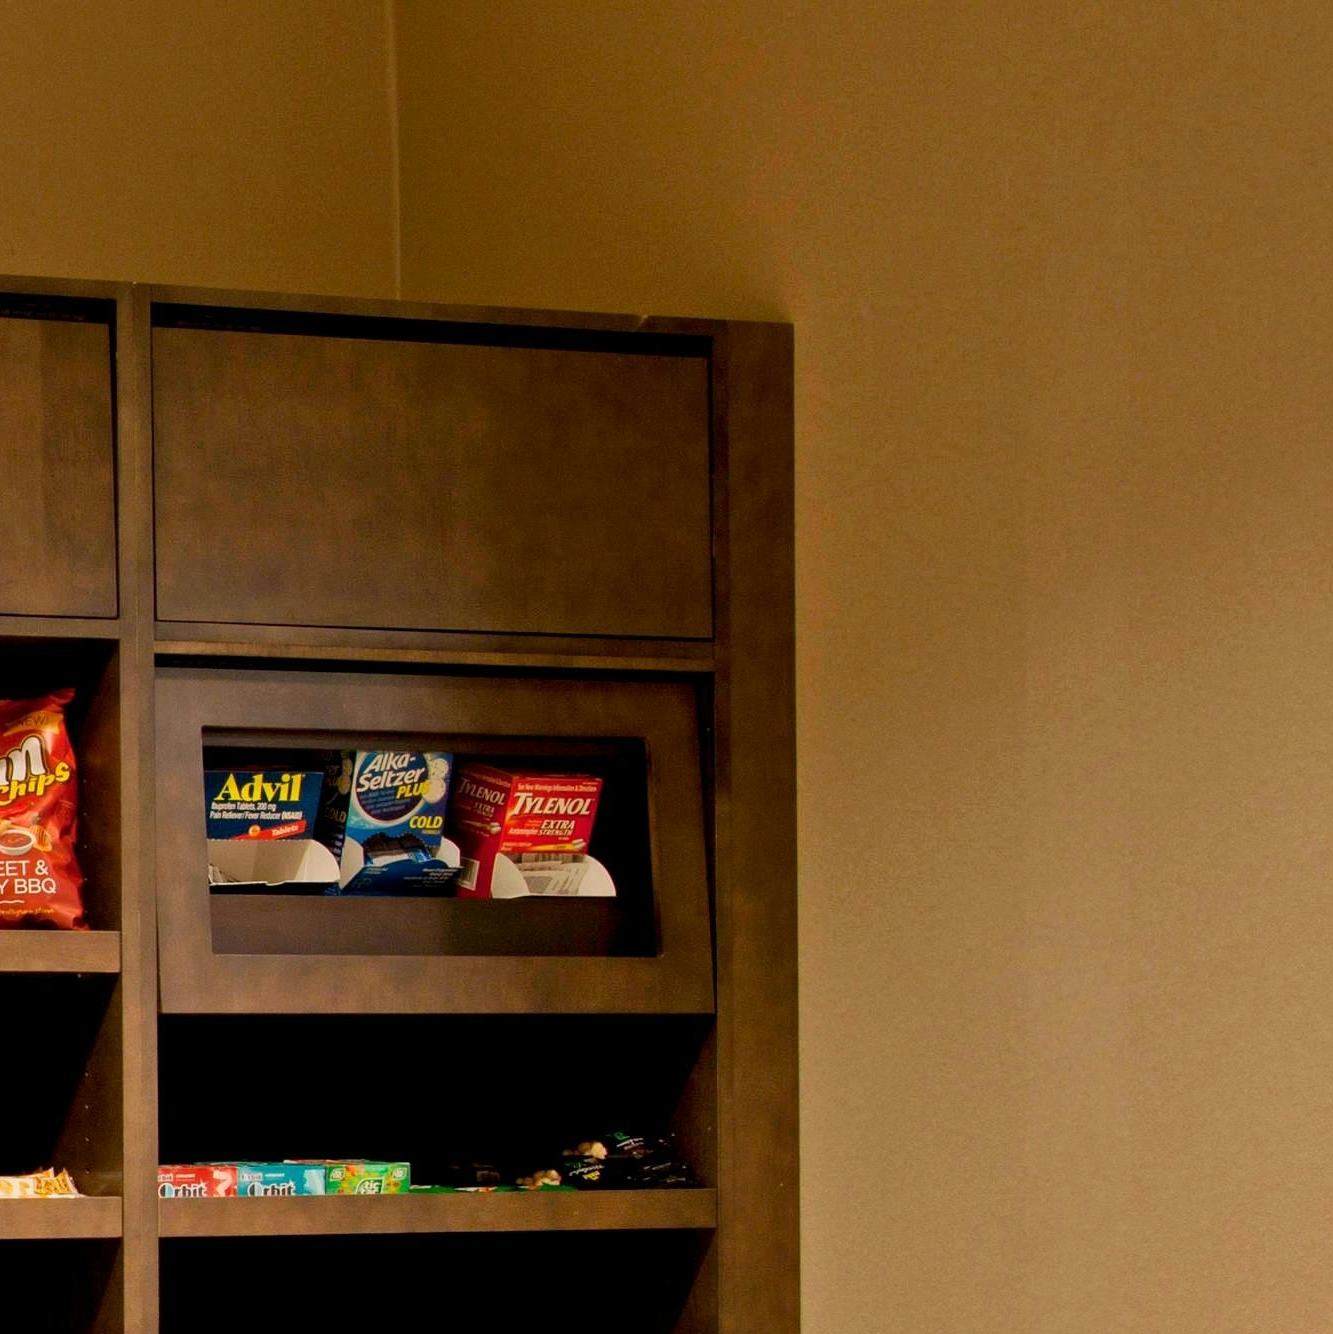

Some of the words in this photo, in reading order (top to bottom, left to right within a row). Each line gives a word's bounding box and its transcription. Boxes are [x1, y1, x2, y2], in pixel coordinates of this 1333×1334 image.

[363, 751, 417, 775] Alka-
[214, 773, 303, 802] Advil
[357, 768, 425, 793] Seltzer
[396, 780, 430, 799] PLUS
[460, 778, 506, 806] TYLENOL
[256, 802, 267, 810] 200
[512, 792, 593, 815] TYLENOL
[409, 816, 443, 829] COLD
[541, 820, 575, 830] EXTRA
[35, 859, 49, 876] &
[14, 877, 57, 894] BBQ
[158, 1181, 207, 1198] Orbit
[247, 1180, 296, 1196] Orbit
